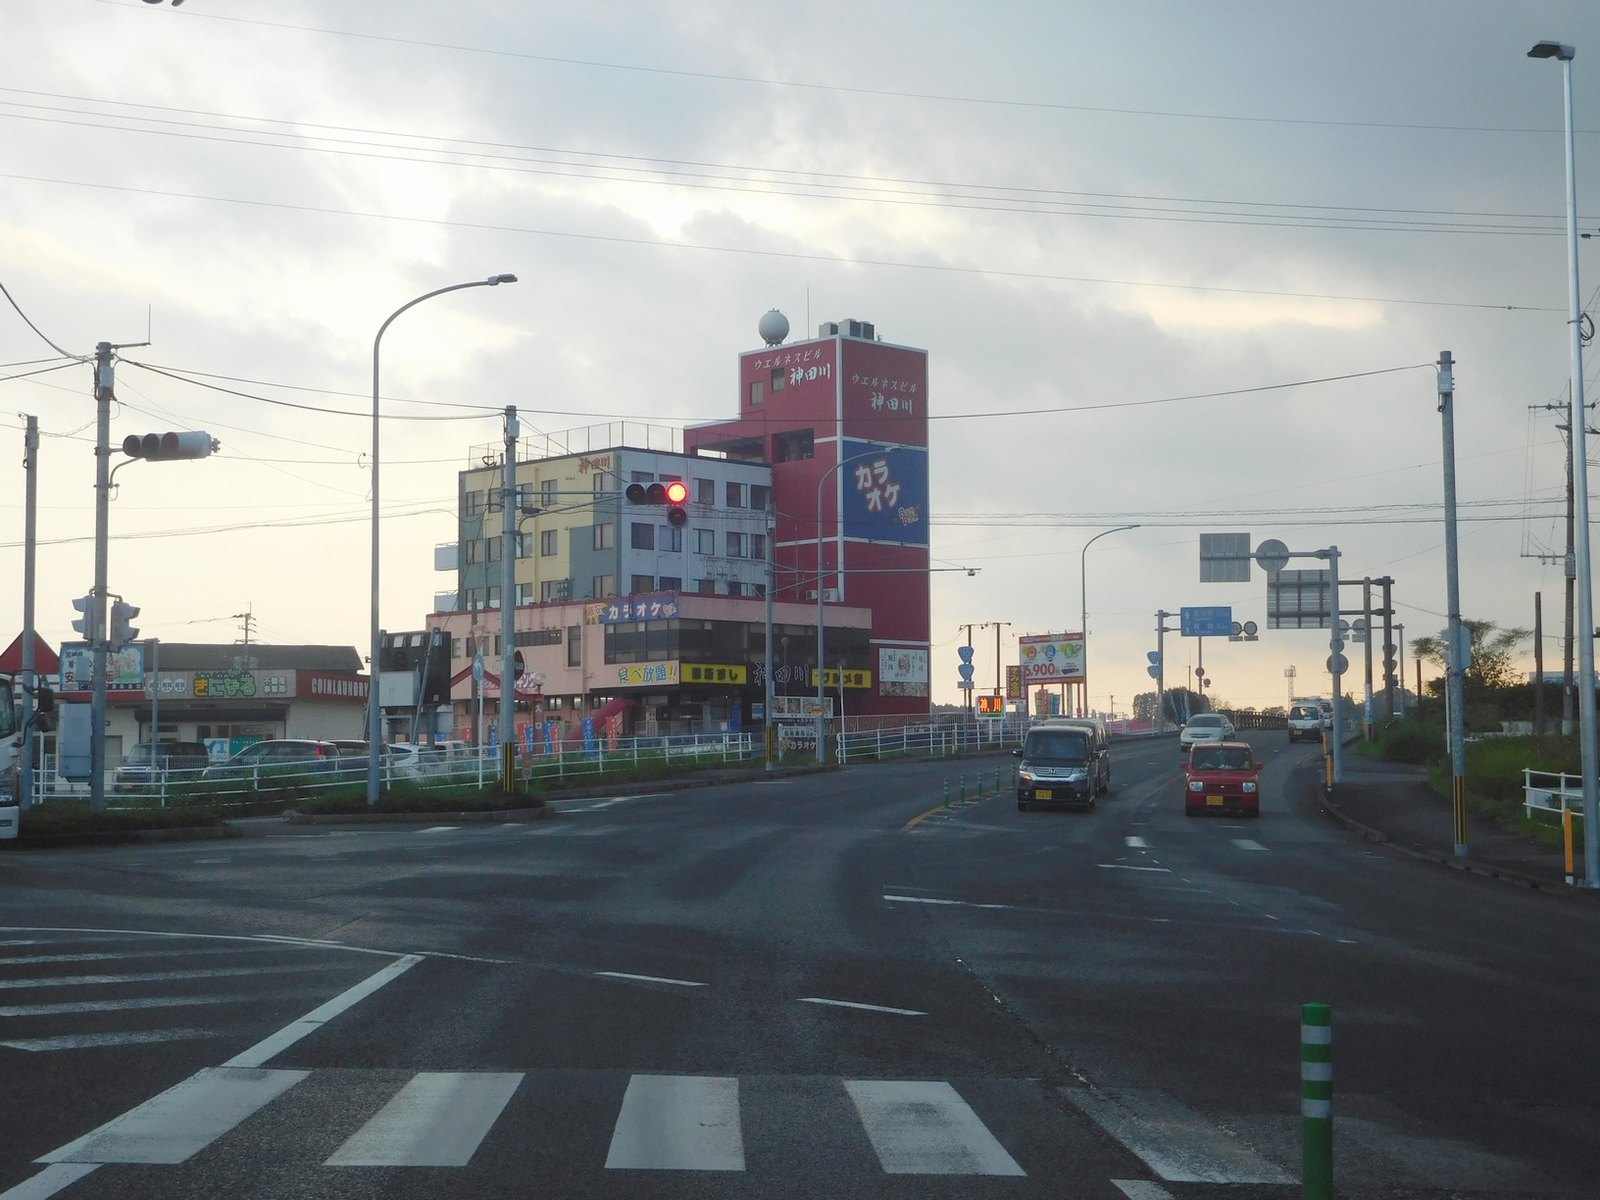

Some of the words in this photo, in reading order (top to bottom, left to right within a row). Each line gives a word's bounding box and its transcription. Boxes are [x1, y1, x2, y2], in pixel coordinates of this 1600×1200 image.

[754, 348, 823, 370] ウエルネスビル
[789, 363, 831, 386] 神田川
[851, 373, 918, 393] ウエルネスビル
[870, 391, 913, 414] 神田川
[578, 455, 611, 474] 神田川
[608, 602, 662, 620] カラオケ
[193, 676, 257, 697] きになる
[790, 740, 817, 751] カラオケ
